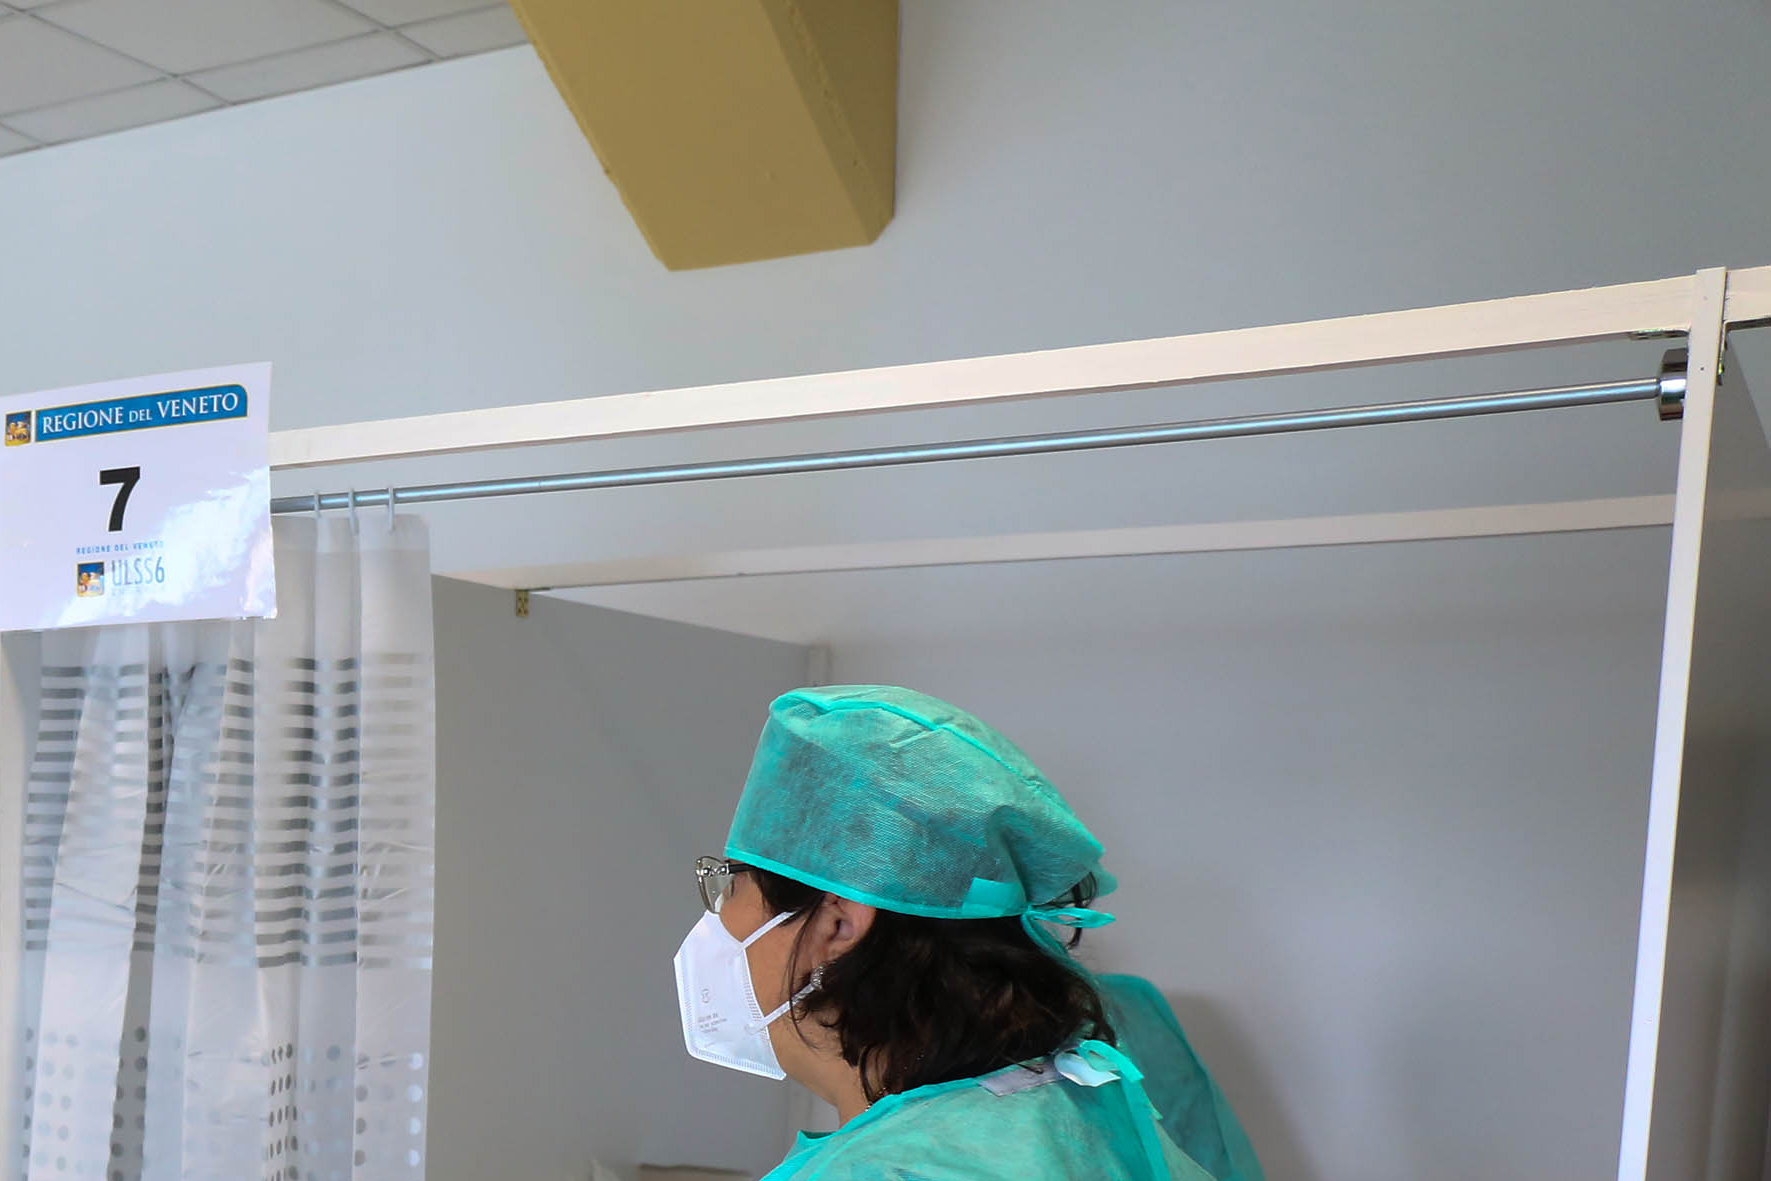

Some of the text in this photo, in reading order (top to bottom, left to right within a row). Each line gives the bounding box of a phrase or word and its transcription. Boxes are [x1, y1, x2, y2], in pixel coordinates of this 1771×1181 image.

[42, 392, 239, 434] REGIONE DEL VENETO
[99, 466, 141, 532] 7
[111, 556, 165, 586] ULSS6
